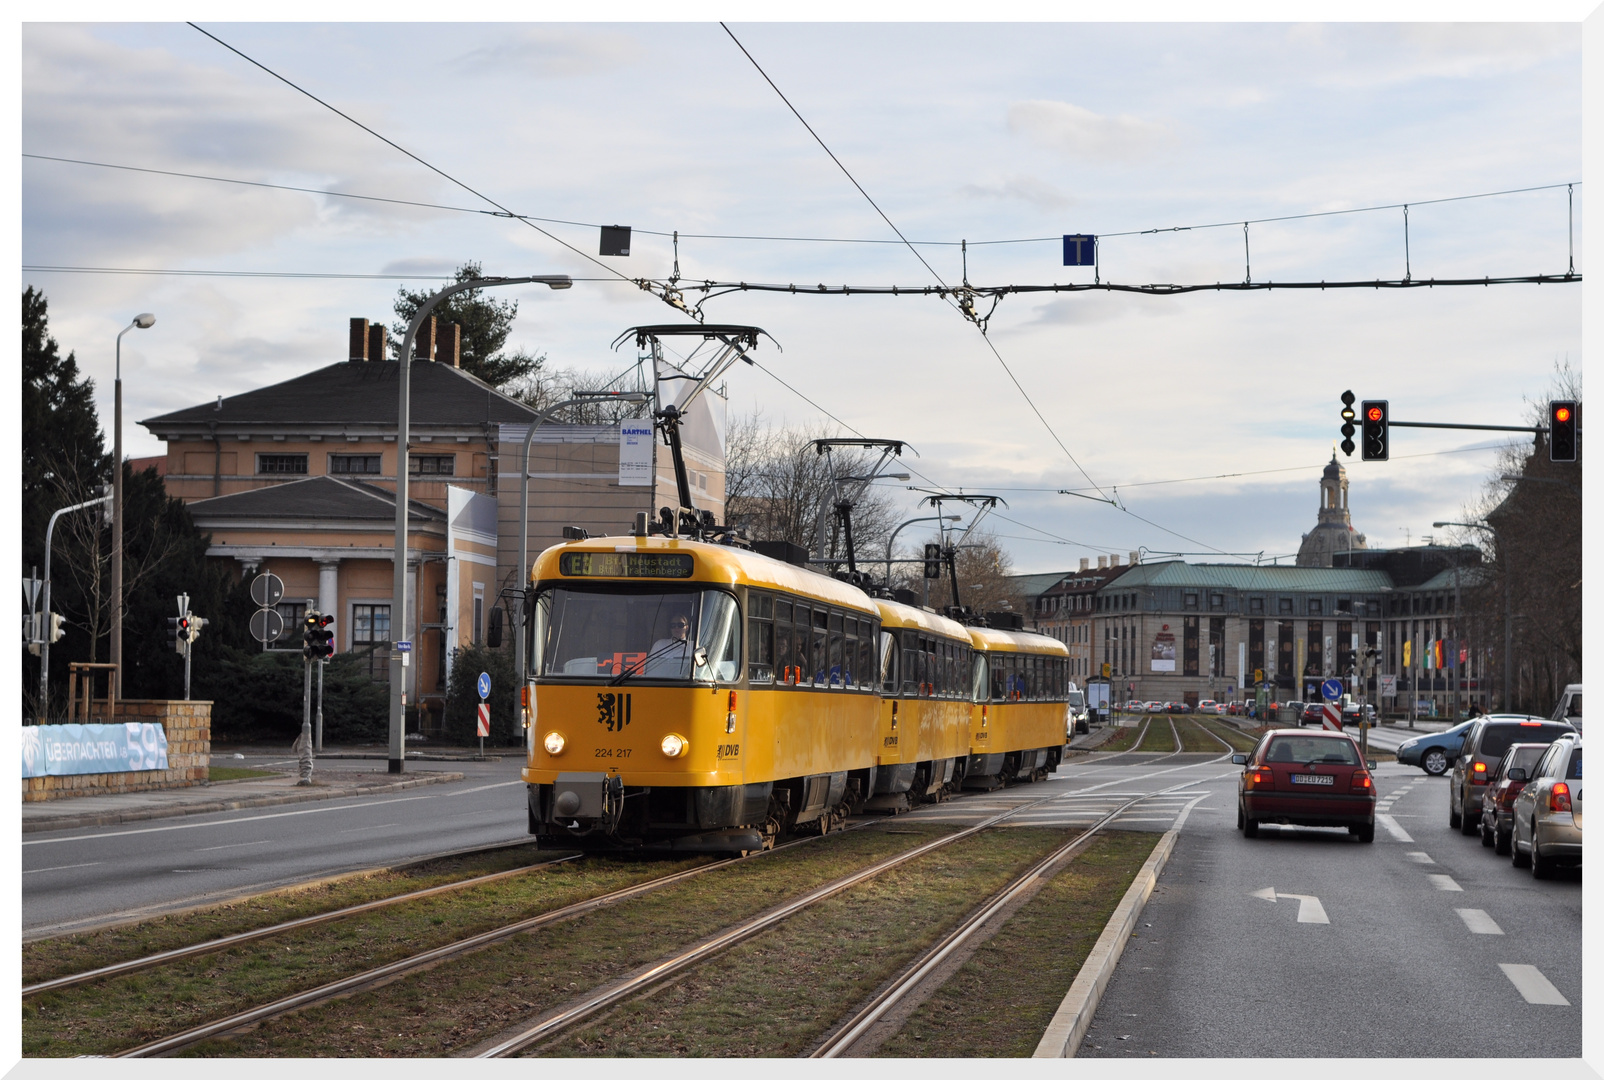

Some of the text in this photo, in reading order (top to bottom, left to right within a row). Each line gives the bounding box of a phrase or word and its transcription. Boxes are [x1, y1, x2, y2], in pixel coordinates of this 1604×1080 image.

[1069, 237, 1088, 263] T
[571, 555, 592, 574] E3
[629, 557, 681, 566] Neustadt
[623, 565, 688, 576] Trachenberge
[46, 738, 117, 761] ÜBERNACHTEN
[595, 748, 632, 758] 224 217
[725, 744, 740, 756] DVB
